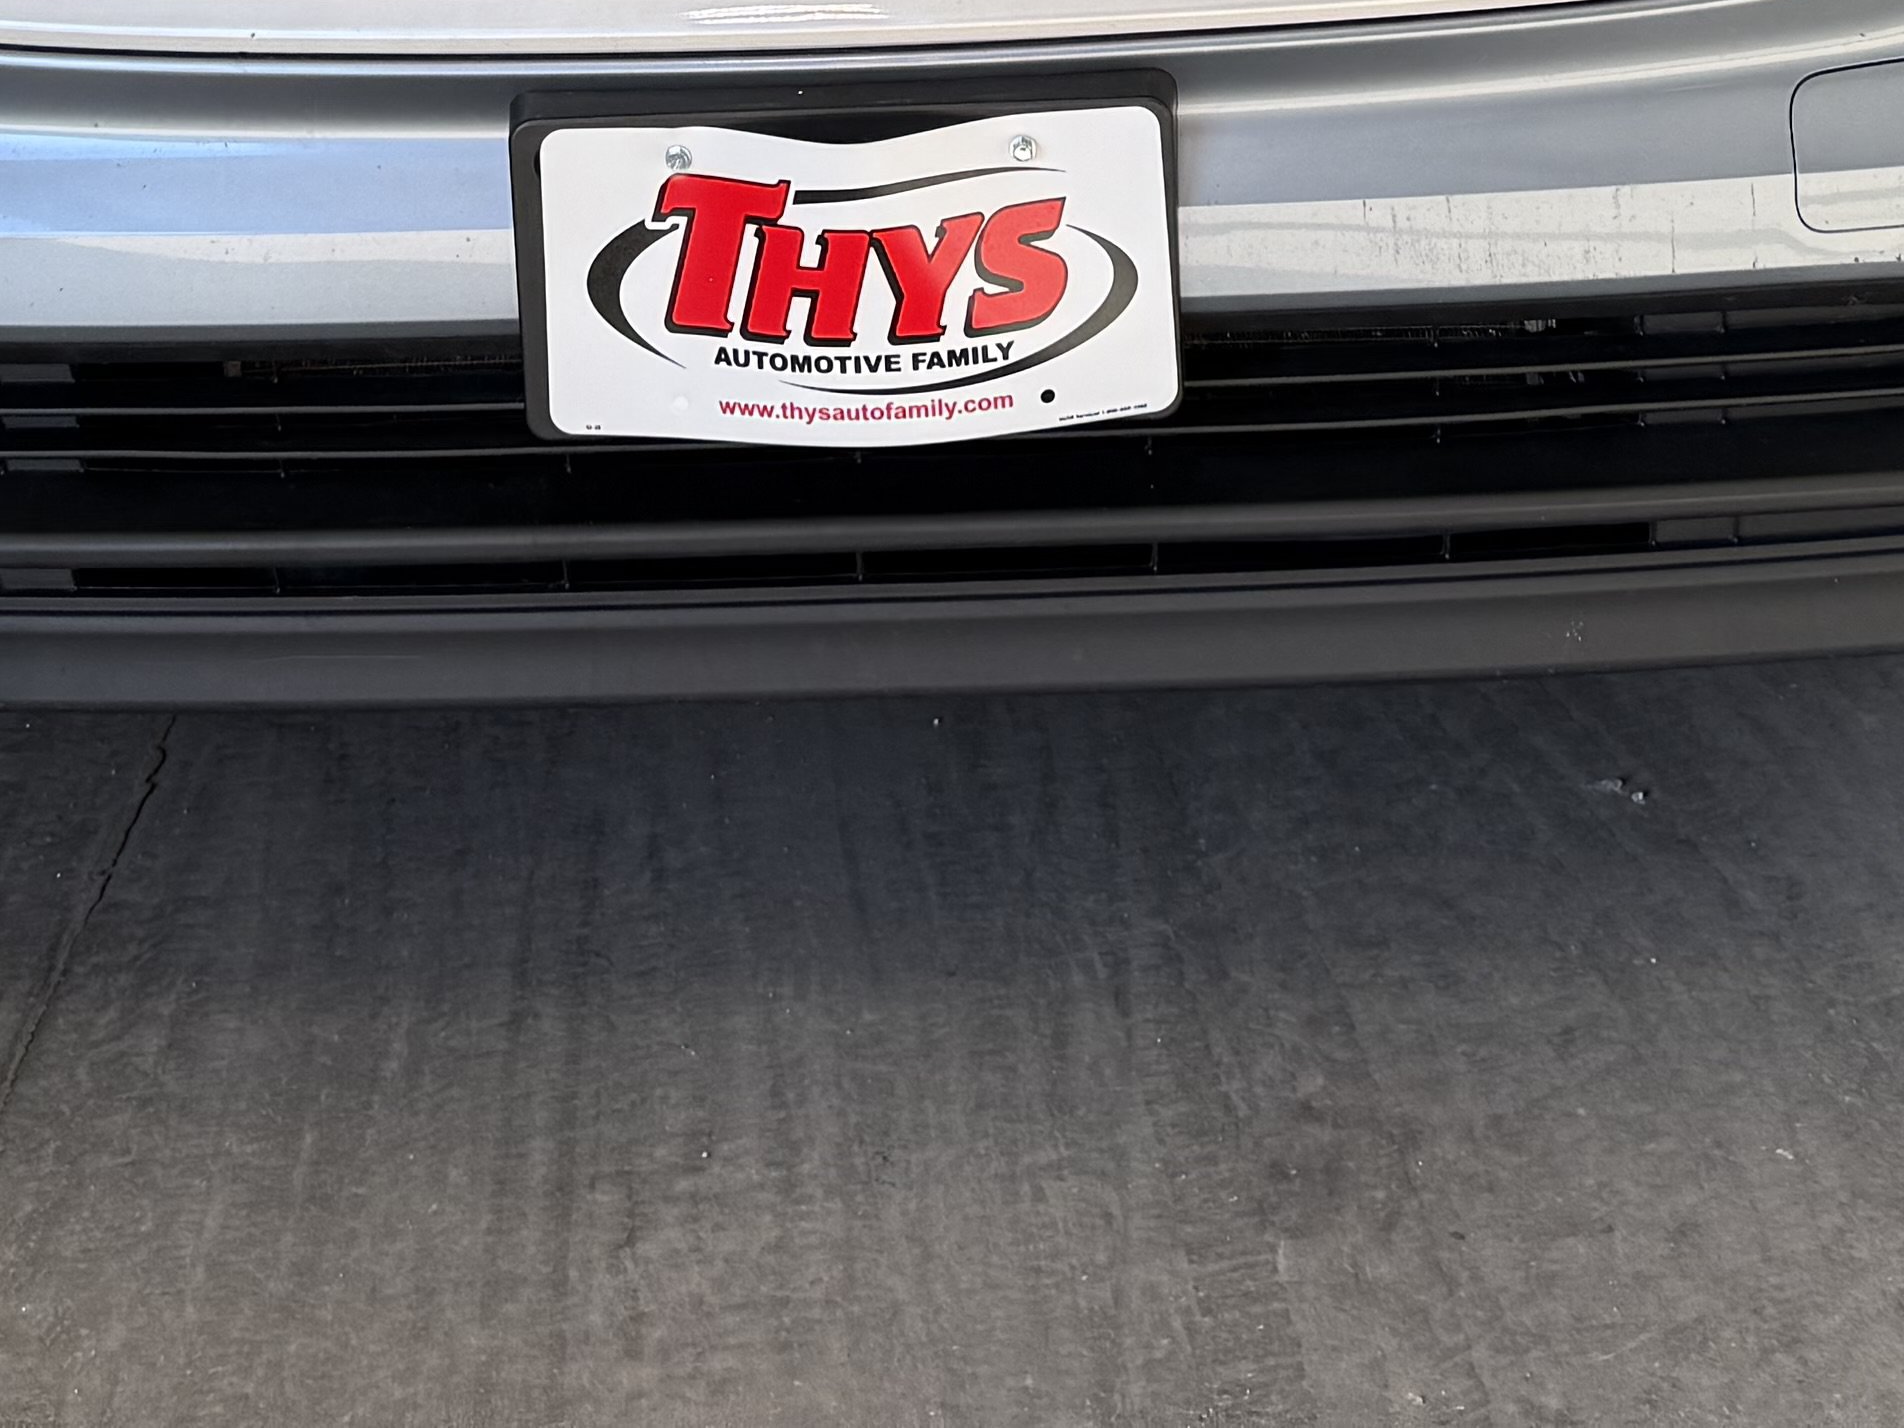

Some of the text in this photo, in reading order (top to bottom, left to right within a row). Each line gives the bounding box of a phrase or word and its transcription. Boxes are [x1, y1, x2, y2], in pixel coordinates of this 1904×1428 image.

[652, 173, 1068, 347] THYS
[713, 339, 1015, 374] AUTOMOTIVE FAMILY
[718, 391, 1015, 425] www.thysautofamily.com
